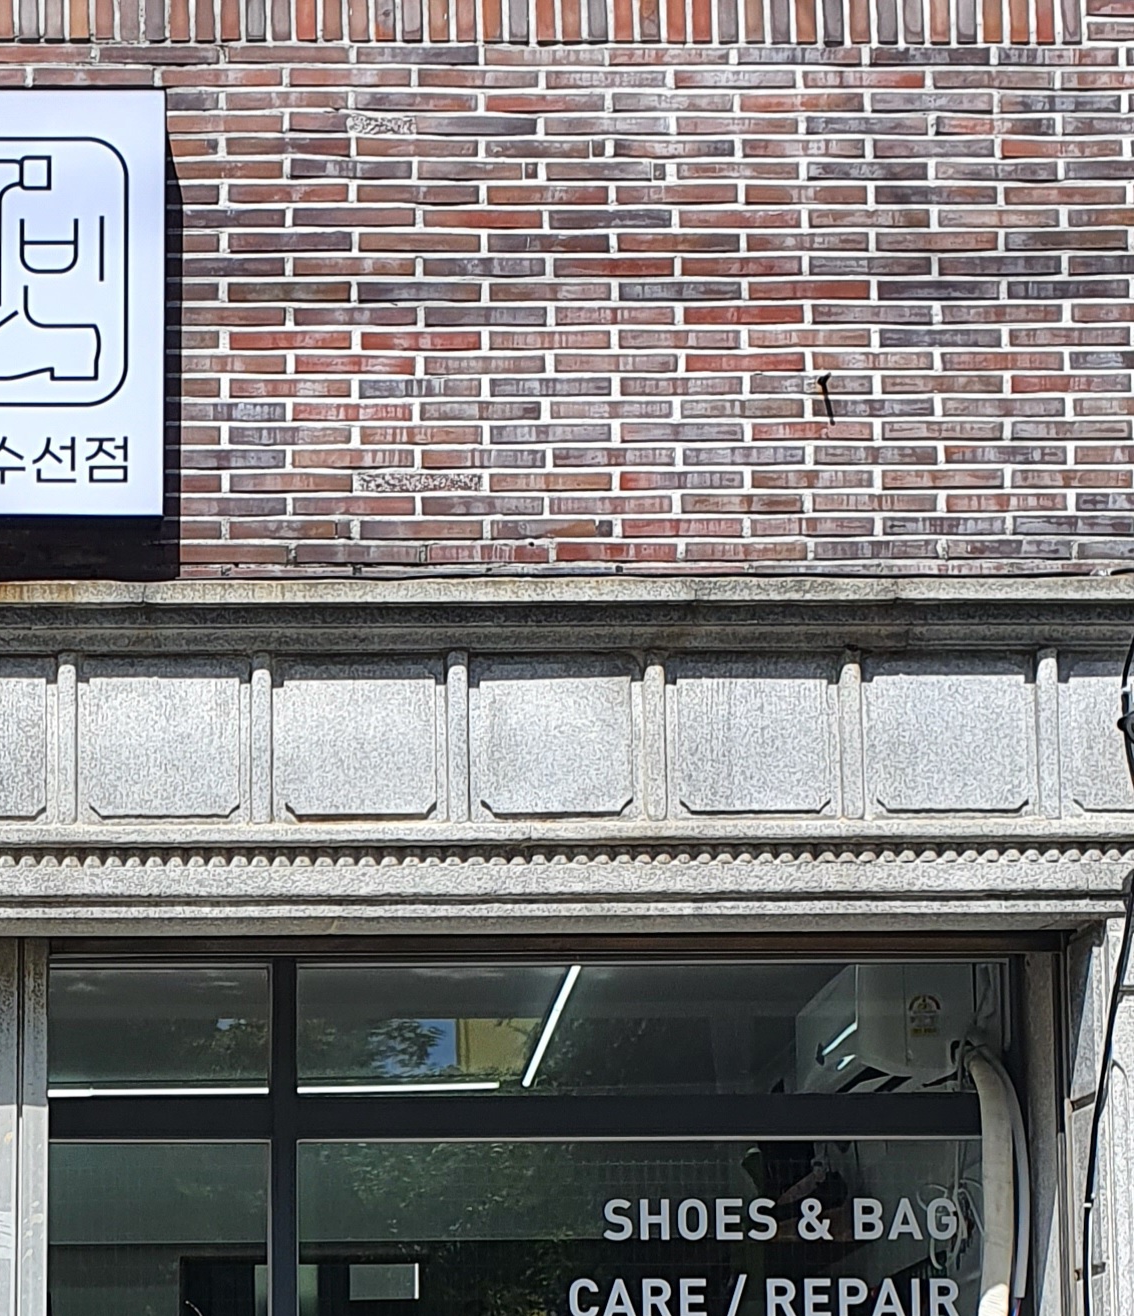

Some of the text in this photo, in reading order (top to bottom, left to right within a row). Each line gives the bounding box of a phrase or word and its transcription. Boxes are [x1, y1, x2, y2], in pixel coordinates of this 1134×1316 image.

[602, 1197, 959, 1242] SHOES & BAG
